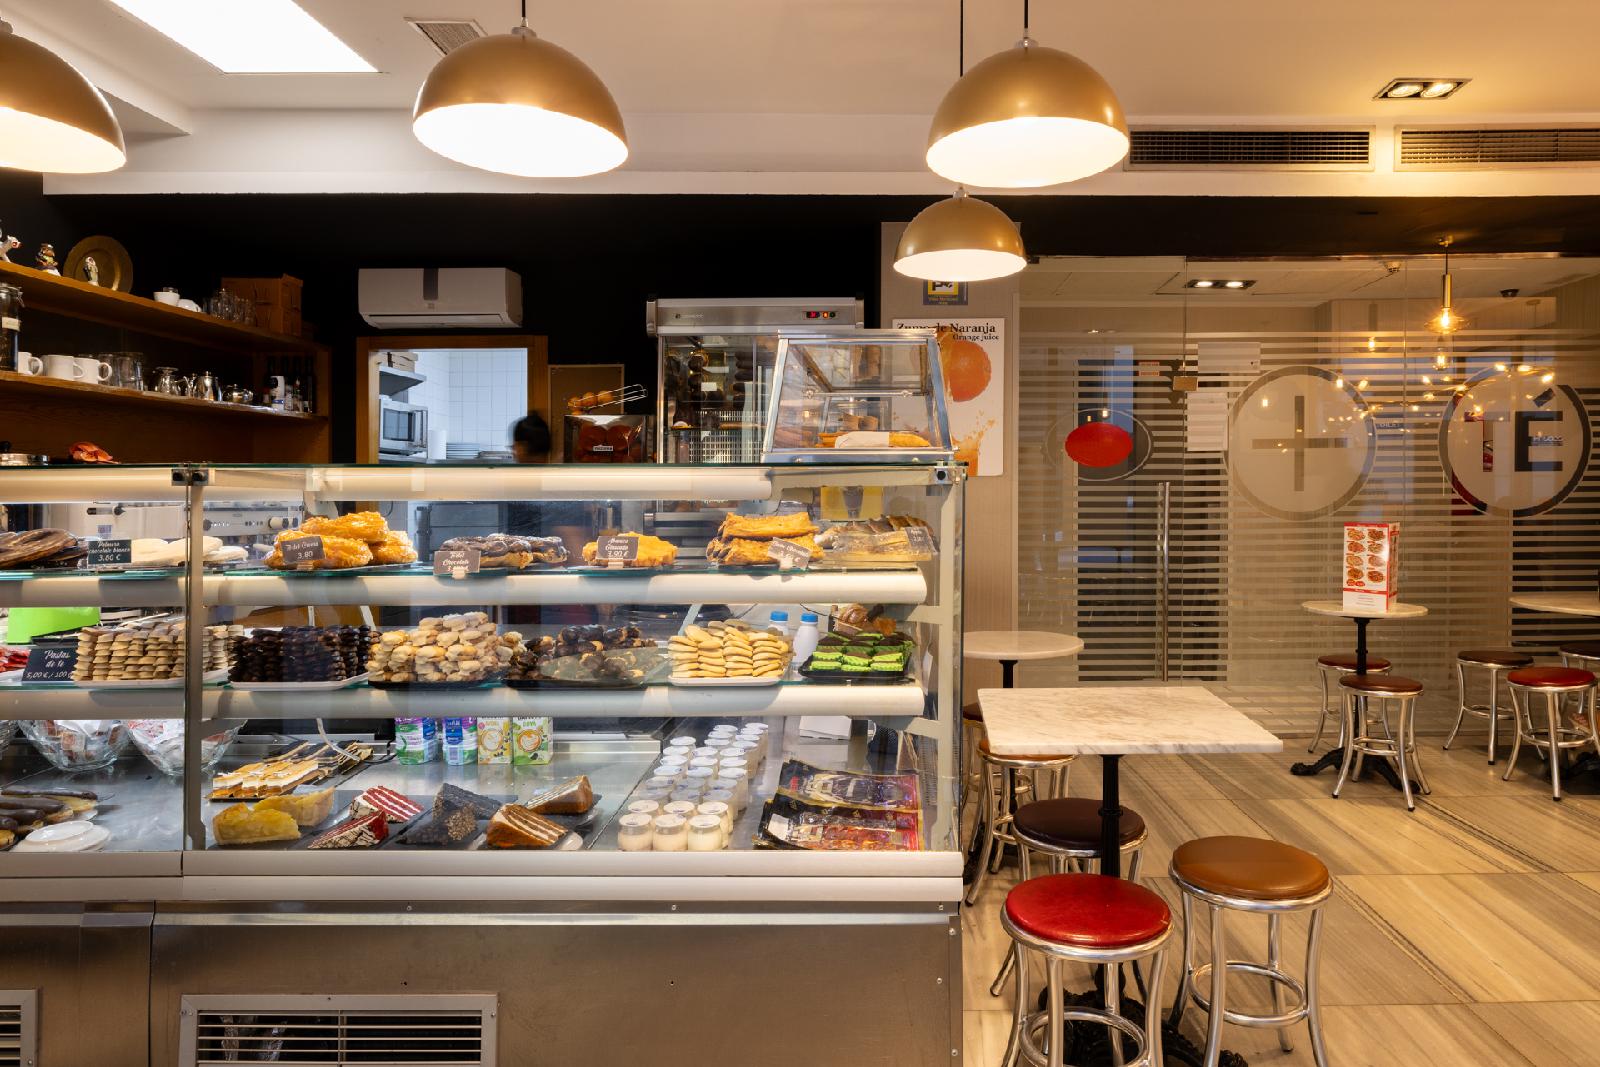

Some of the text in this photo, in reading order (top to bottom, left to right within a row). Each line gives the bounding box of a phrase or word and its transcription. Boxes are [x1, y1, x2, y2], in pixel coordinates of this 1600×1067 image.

[950, 322, 995, 333] Naranja
[953, 333, 999, 341] Orange juice
[1464, 388, 1563, 472] TÉ
